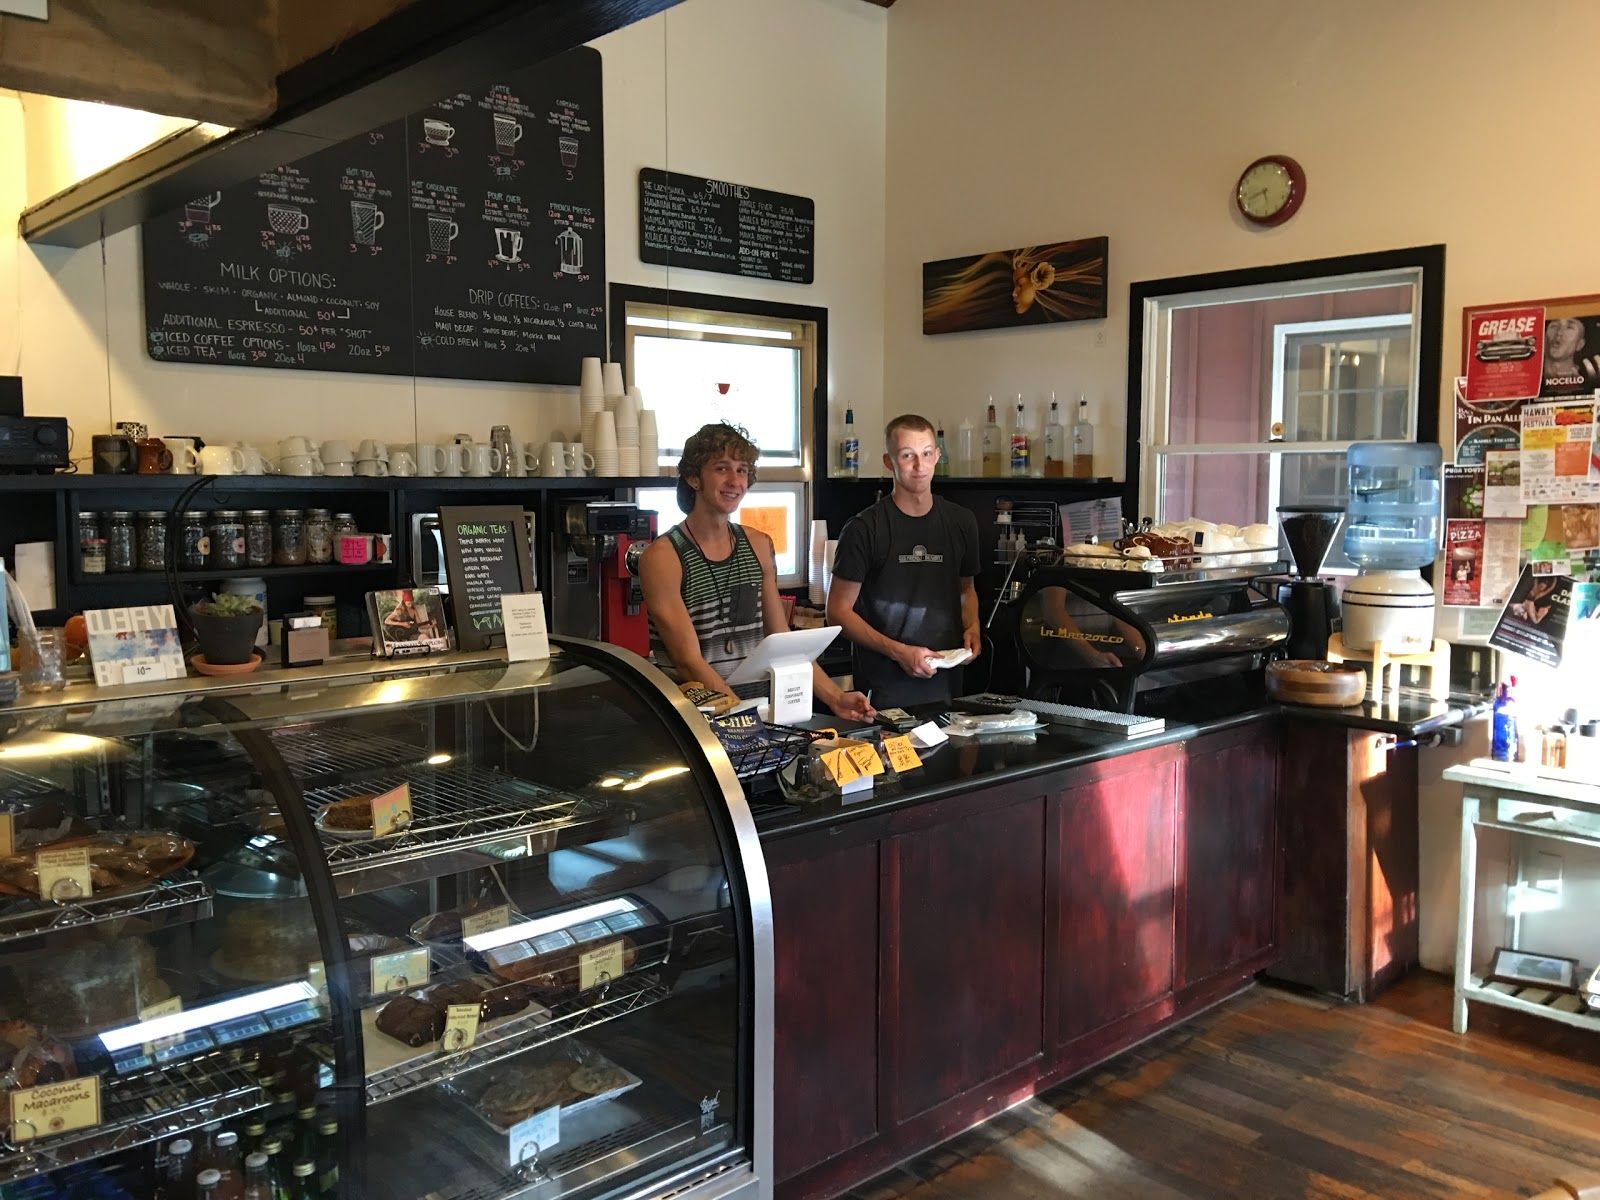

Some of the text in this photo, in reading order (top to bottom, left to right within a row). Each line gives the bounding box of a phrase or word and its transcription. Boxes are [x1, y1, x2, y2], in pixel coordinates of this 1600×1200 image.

[220, 262, 336, 288] MILK OPTIONS:
[158, 282, 191, 293] WHOLE
[203, 285, 230, 296] SKIM
[241, 288, 278, 300] ORGANIC
[286, 293, 318, 305] ALMOND
[364, 300, 380, 312] SOY
[468, 288, 494, 306] DRIP
[163, 312, 222, 330] ADDITIONAL
[264, 306, 310, 320] ADDITIONAL
[434, 305, 455, 318] HOUSE
[458, 310, 478, 321] BLEND
[1478, 316, 1537, 336] GREASE
[166, 332, 190, 344] ICED
[194, 334, 235, 348] COFFEE
[436, 334, 456, 346] COLD
[500, 340, 506, 351] 3
[530, 342, 536, 353] 4
[166, 345, 190, 357] ICED
[297, 352, 305, 364] 4
[1546, 376, 1585, 386] NOCELLO
[1468, 414, 1483, 424] TIN
[1484, 414, 1502, 424] PAN
[458, 524, 488, 536] ORGANIC
[1450, 530, 1482, 541] PIZZA
[31, 1082, 82, 1100] Coconut
[23, 1091, 91, 1112] Macaroons
